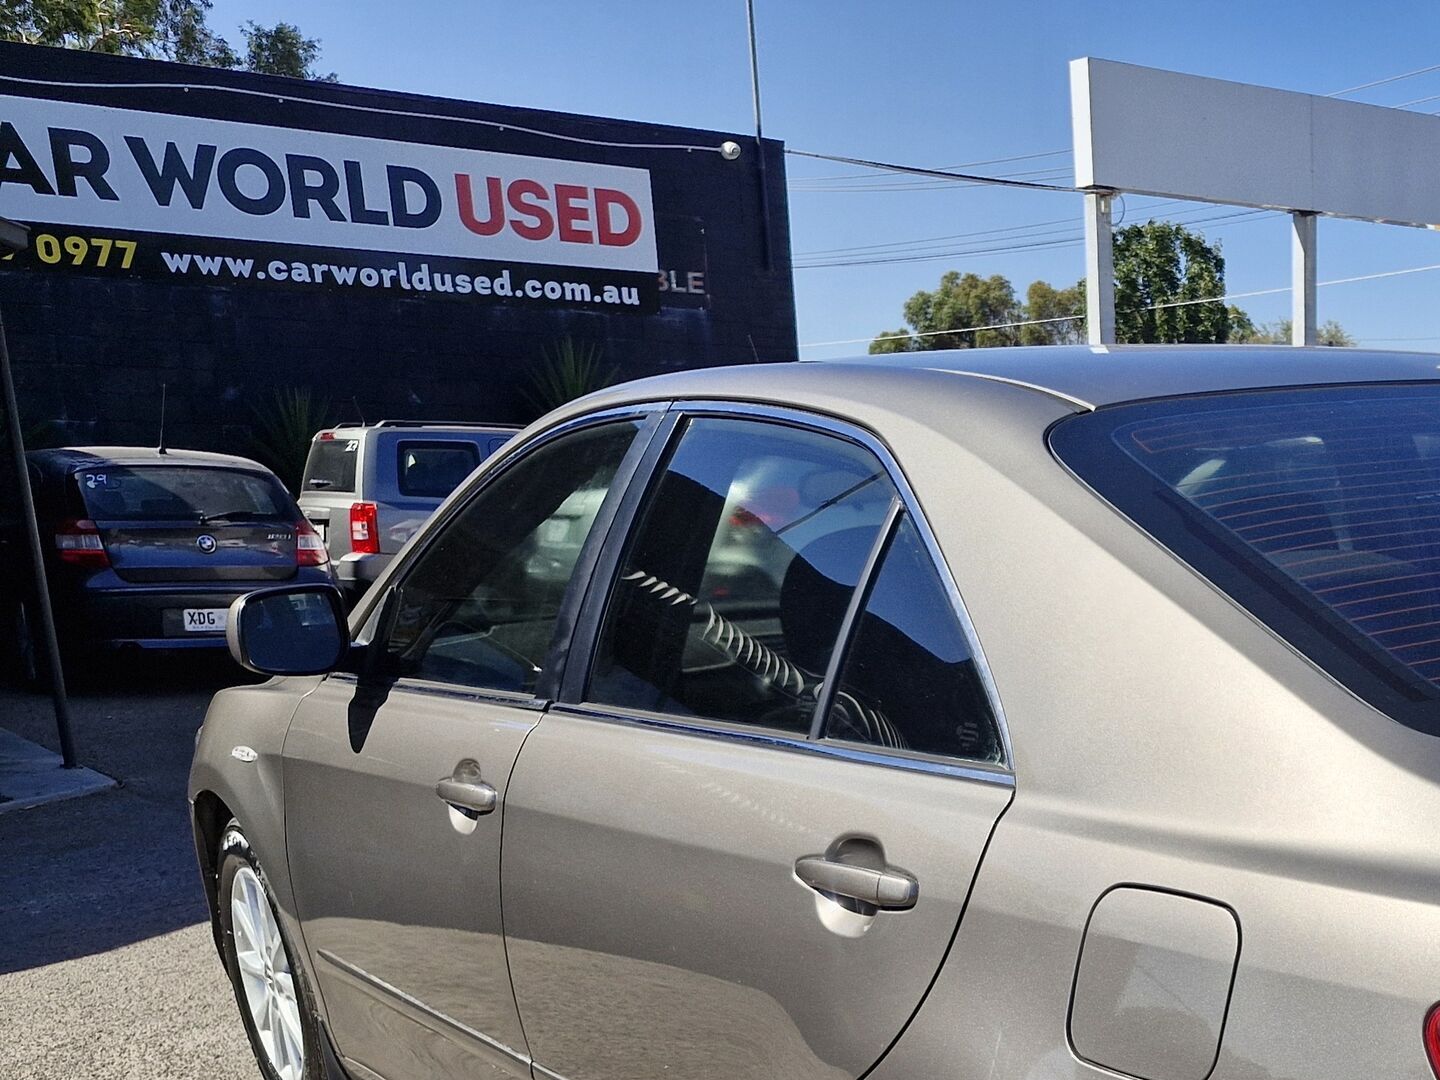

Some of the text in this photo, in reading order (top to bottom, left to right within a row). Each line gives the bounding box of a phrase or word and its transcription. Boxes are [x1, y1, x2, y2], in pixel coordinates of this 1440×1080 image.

[123, 135, 443, 230] WORLD
[454, 172, 644, 248] USED
[35, 233, 640, 306] 0977 www.carworldused.com.au
[86, 474, 107, 489] 29
[187, 611, 216, 625] XDG
